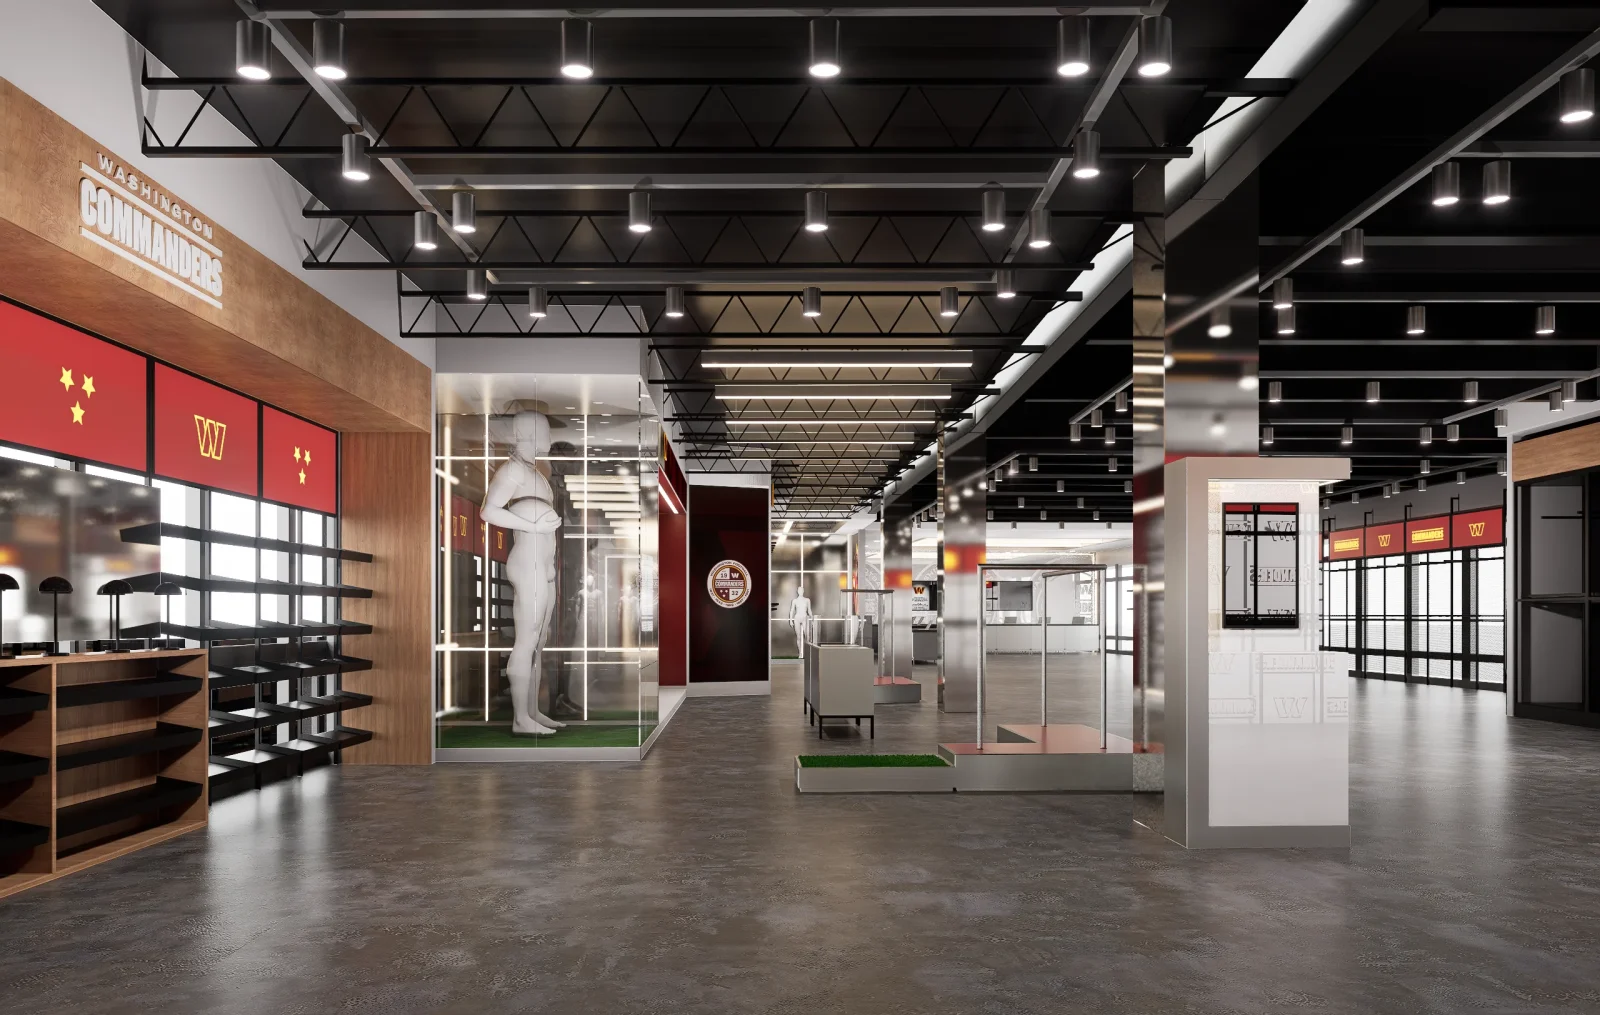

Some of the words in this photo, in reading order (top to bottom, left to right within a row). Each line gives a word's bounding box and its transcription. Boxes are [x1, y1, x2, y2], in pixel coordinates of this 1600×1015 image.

[80, 177, 223, 297] COMMANDERS
[96, 152, 213, 239] WASHINGTON
[194, 414, 227, 461] W
